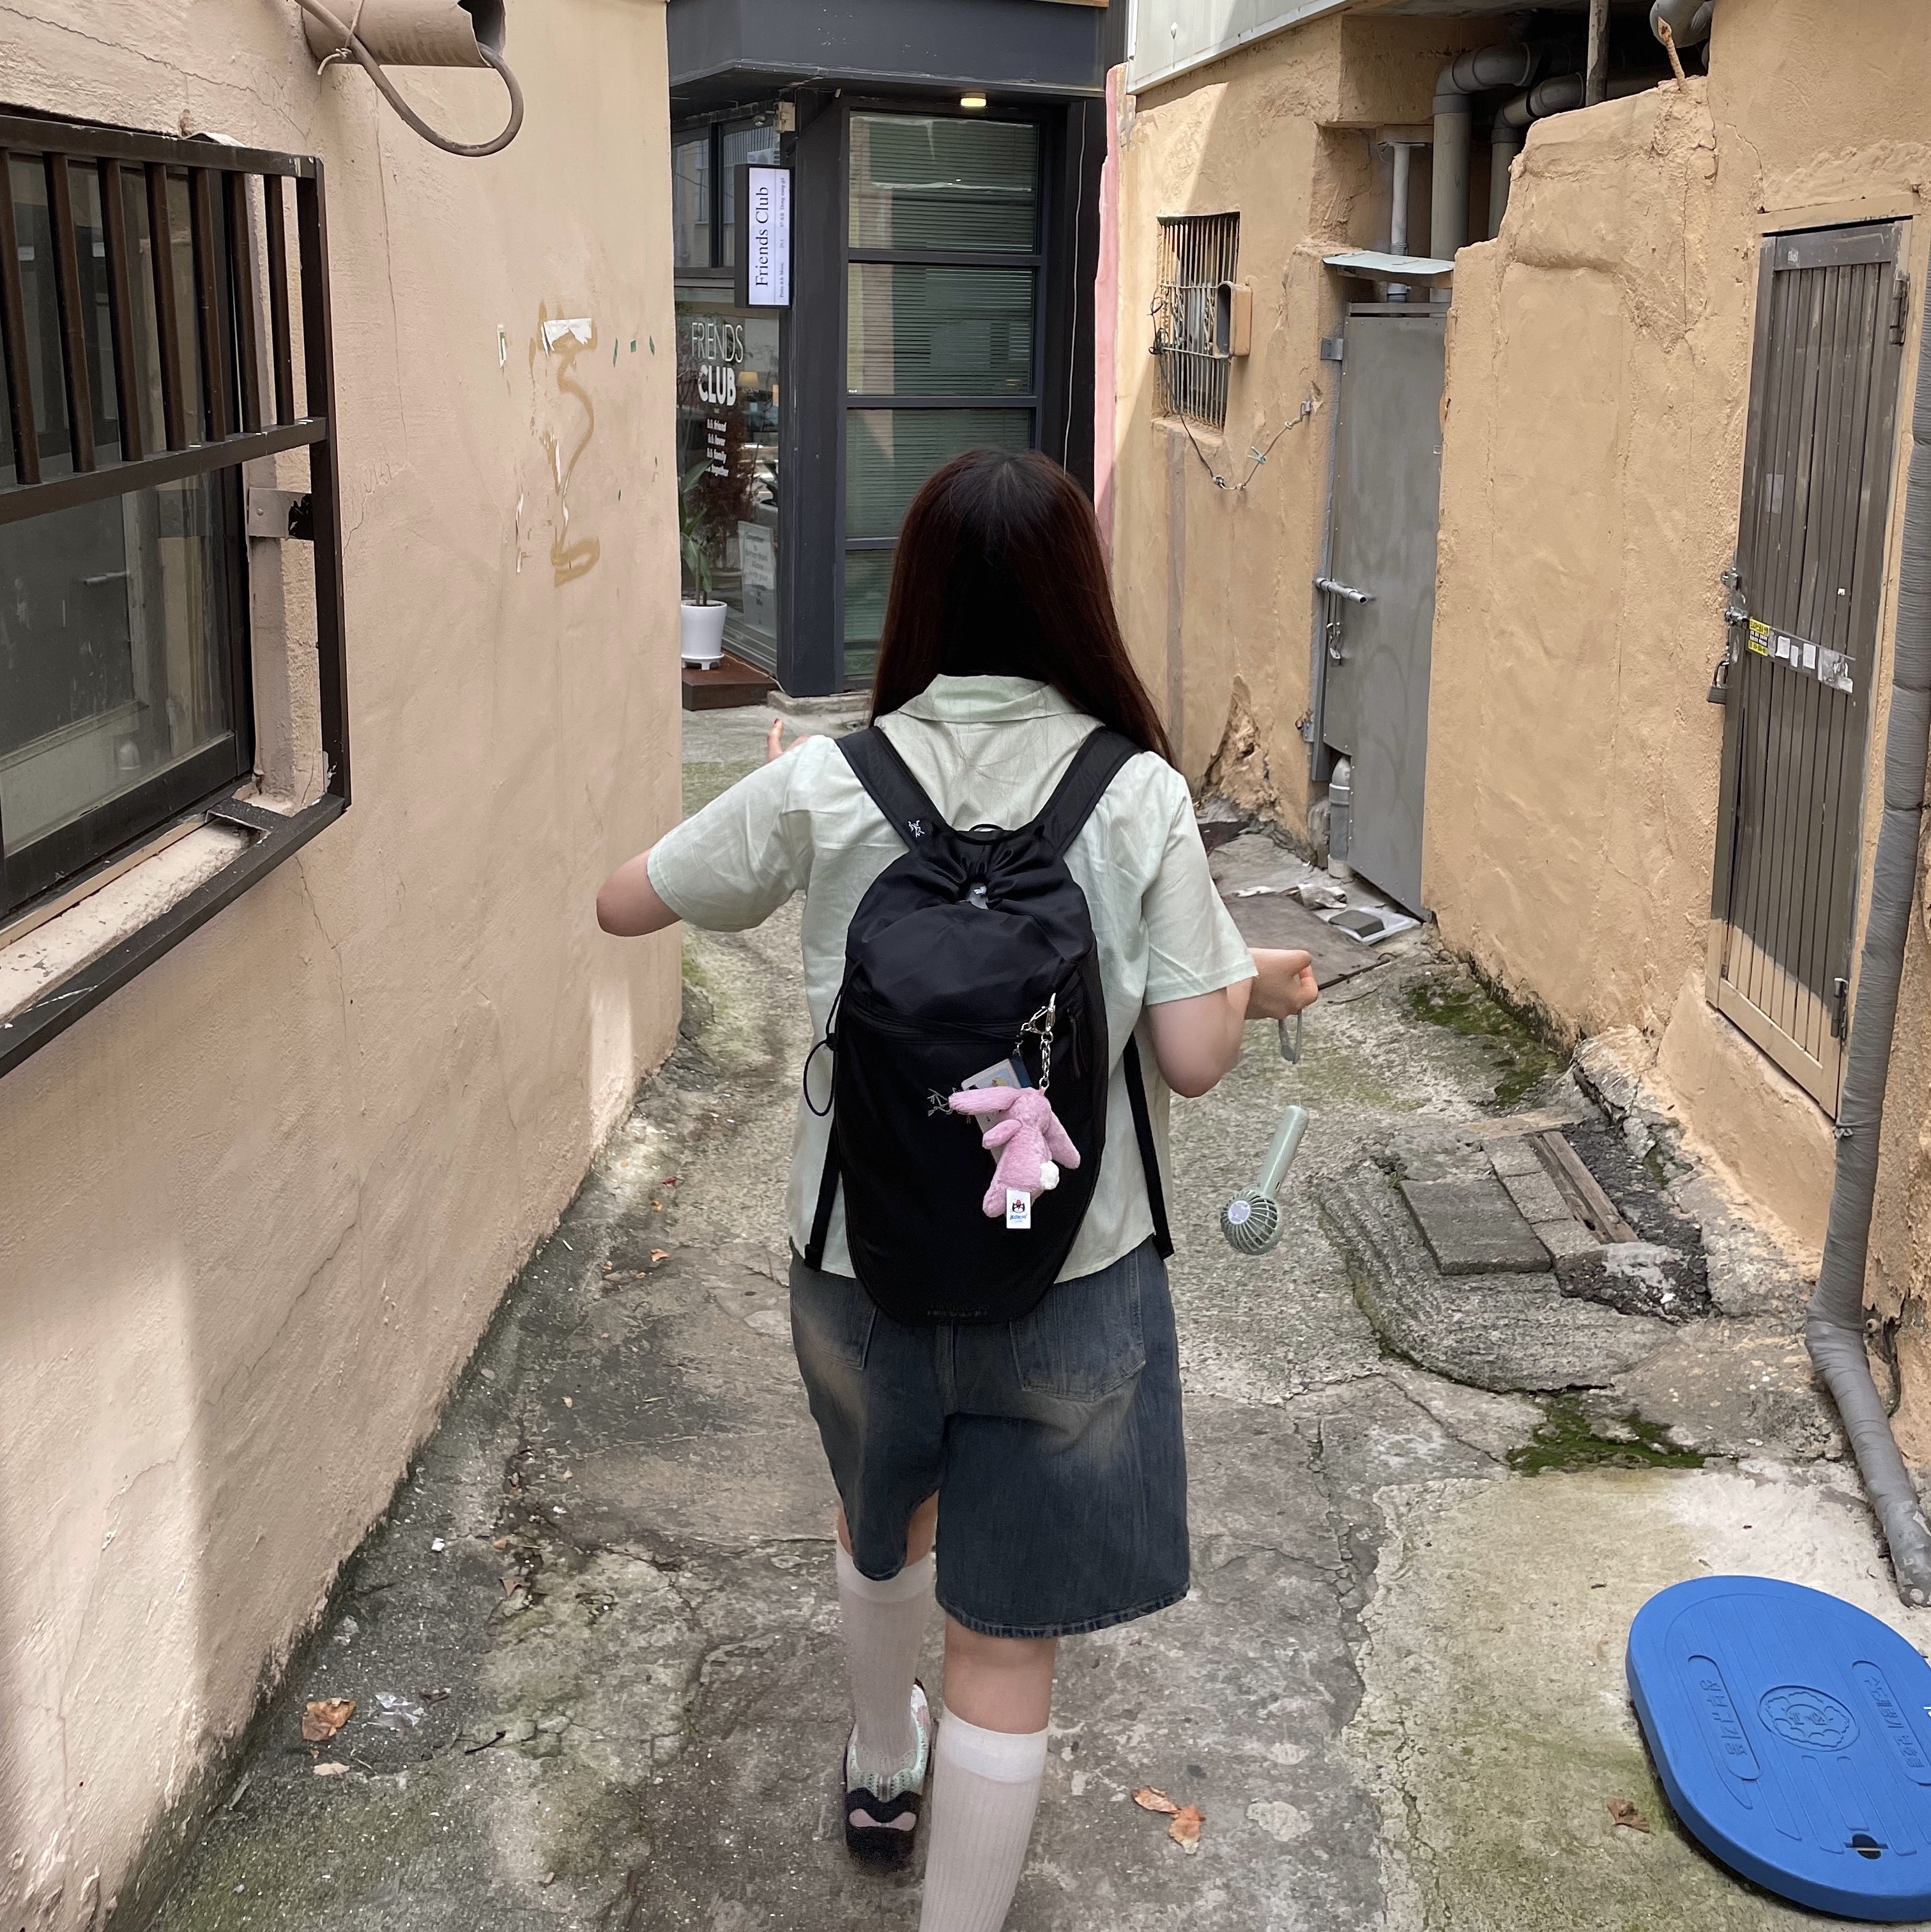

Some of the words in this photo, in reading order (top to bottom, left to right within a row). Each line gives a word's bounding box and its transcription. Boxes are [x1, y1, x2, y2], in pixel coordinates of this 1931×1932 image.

[755, 187, 769, 224] Club
[755, 229, 769, 287] Friends
[691, 322, 744, 364] FRIENDS
[697, 365, 737, 406] CLUB
